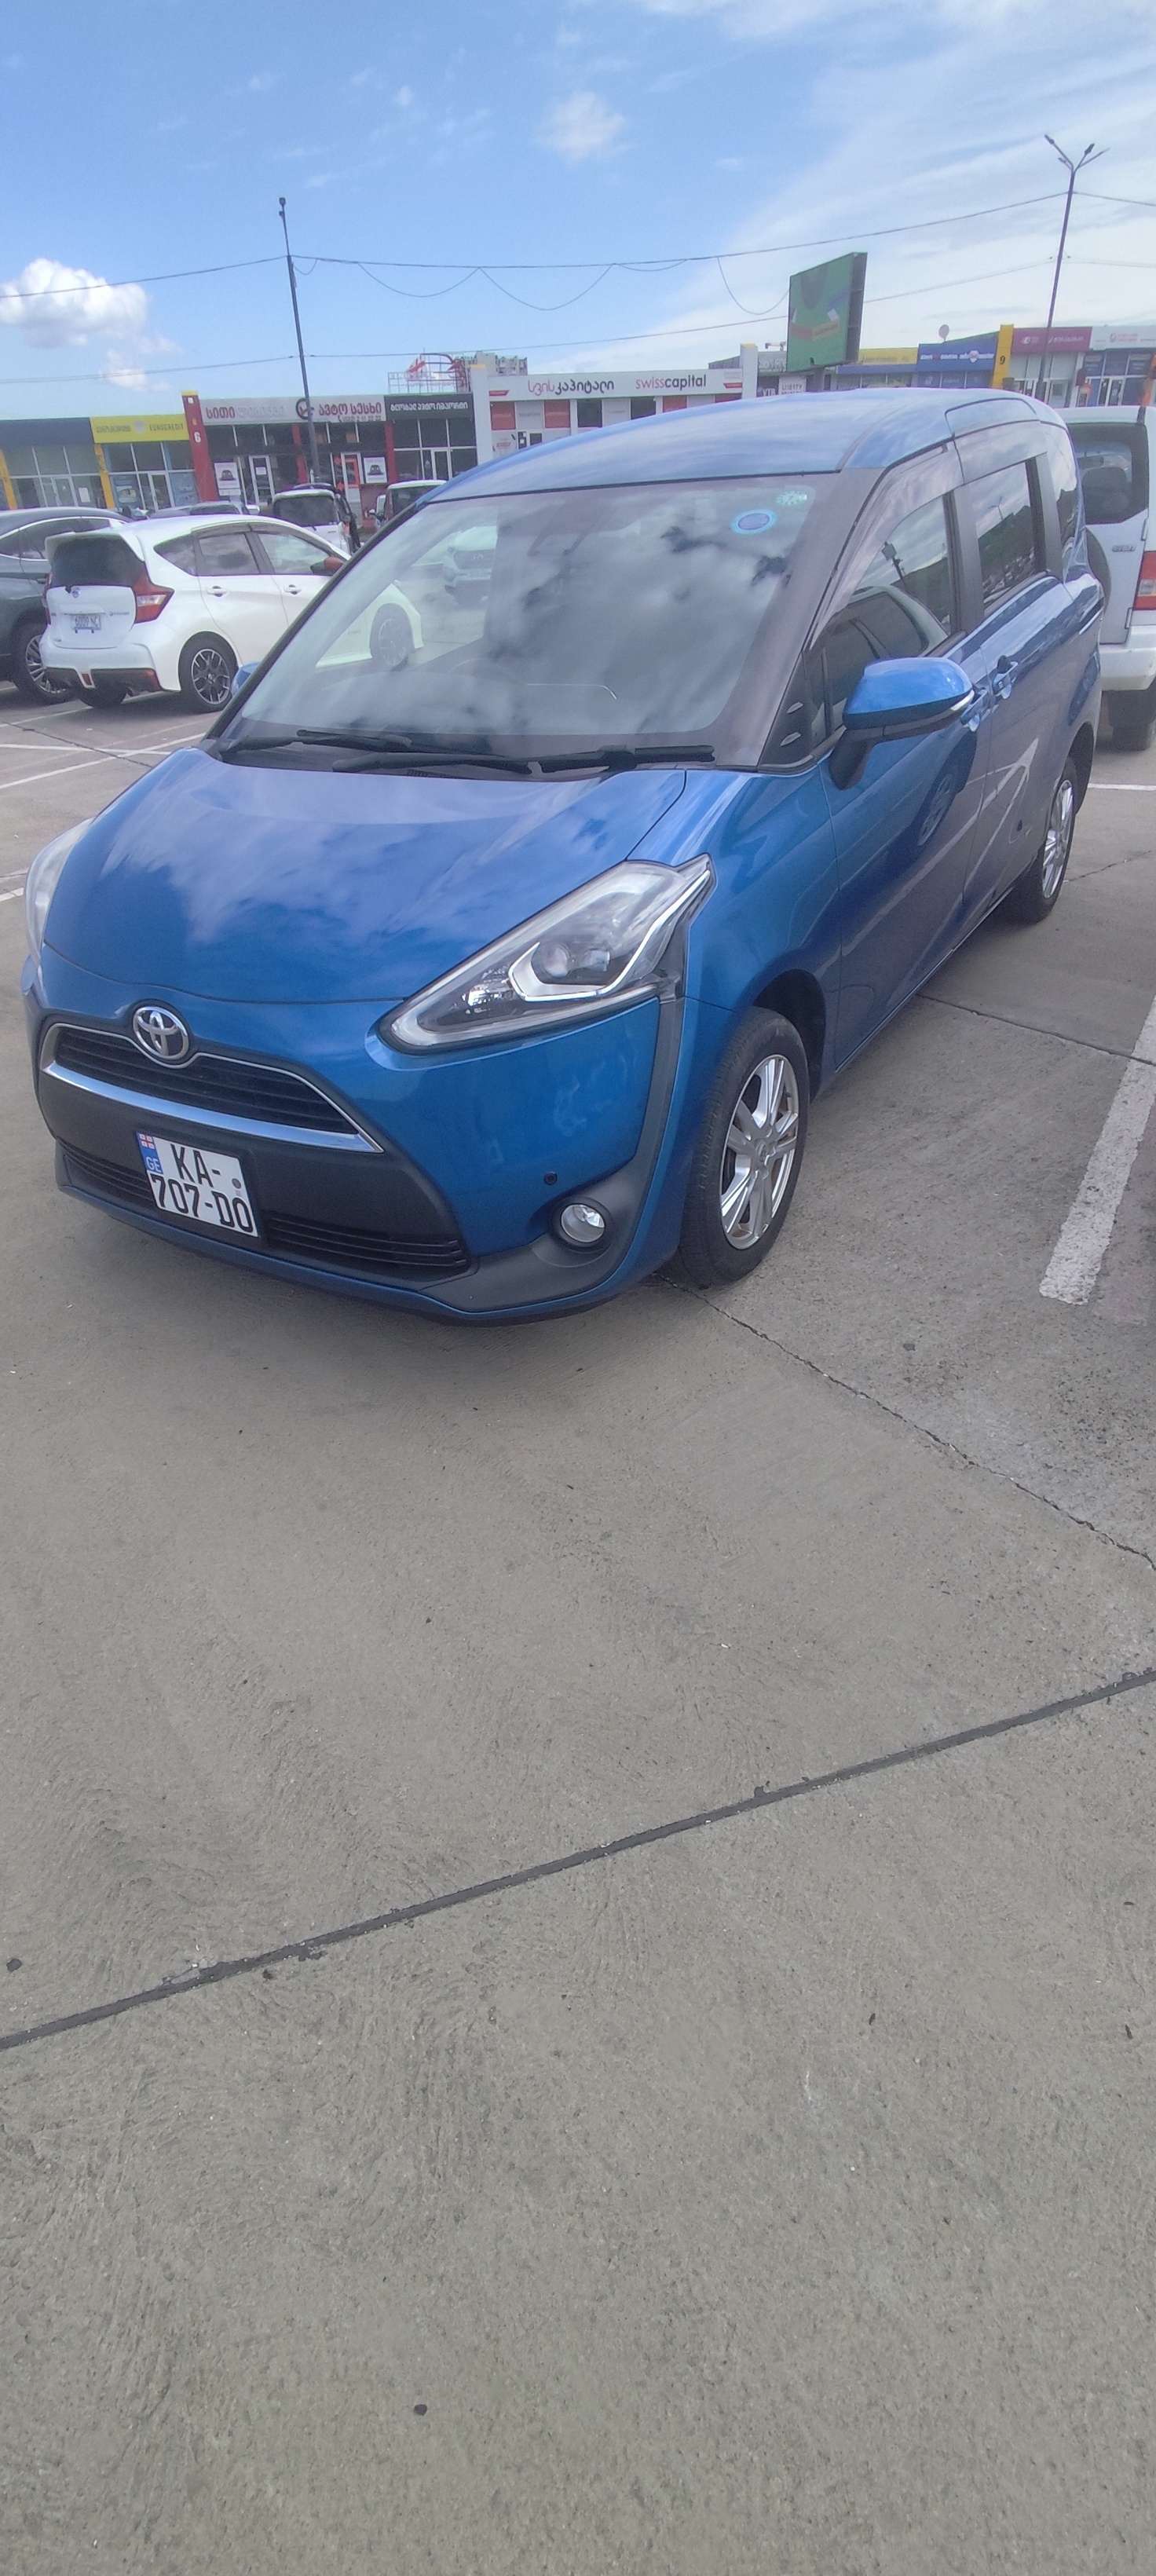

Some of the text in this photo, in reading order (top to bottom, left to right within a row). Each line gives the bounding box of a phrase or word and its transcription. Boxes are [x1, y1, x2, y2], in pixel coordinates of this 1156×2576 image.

[999, 355, 1006, 364] 9
[635, 374, 706, 390] swisscapital
[319, 402, 382, 415] ავტო სესხი
[194, 431, 202, 443] 6
[145, 1156, 162, 1173] GE
[170, 1143, 221, 1187] KA-
